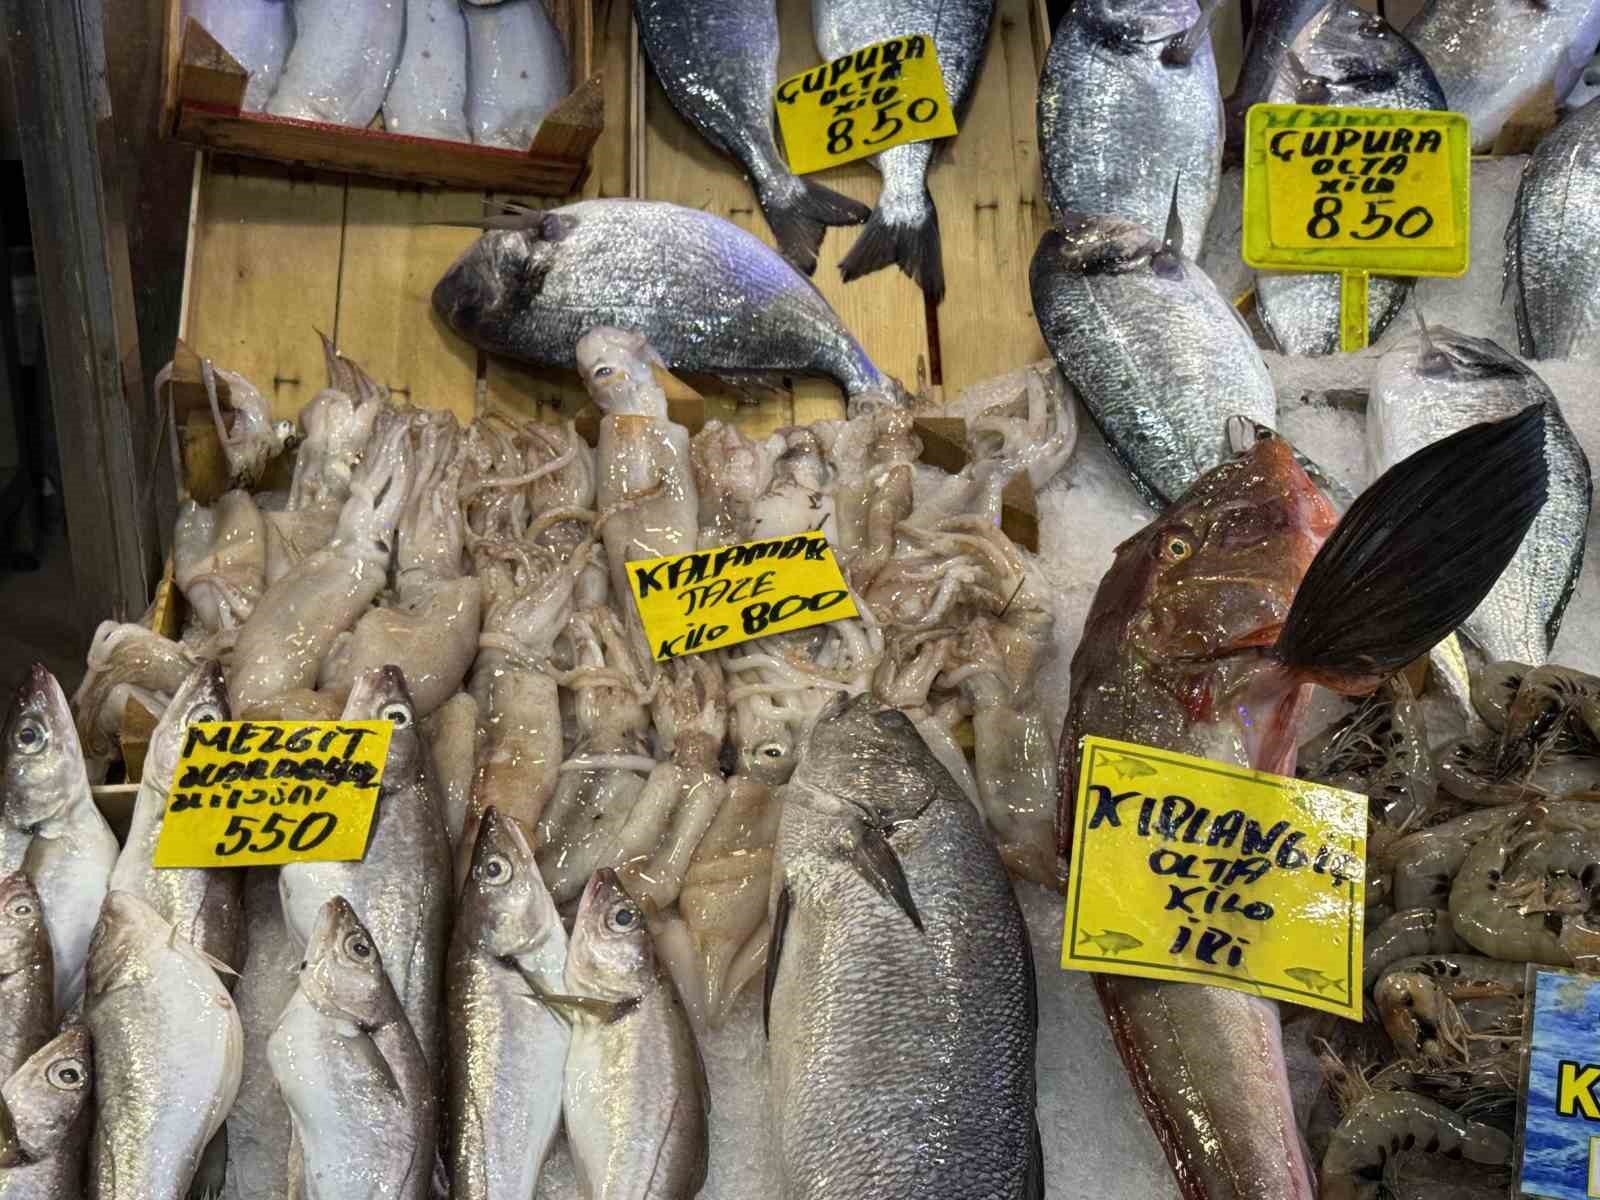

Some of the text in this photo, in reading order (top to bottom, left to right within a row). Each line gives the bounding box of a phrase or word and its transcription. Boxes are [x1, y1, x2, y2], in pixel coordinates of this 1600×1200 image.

[827, 97, 940, 155] 850
[1269, 127, 1443, 162] ÇUPURA
[1311, 154, 1409, 176] OLTA
[1306, 196, 1434, 240] 850
[634, 536, 830, 599] KALAMAR
[677, 571, 776, 616] TAZE
[740, 590, 849, 635] 800
[215, 812, 338, 856] 550
[1149, 848, 1273, 887] OLTA
